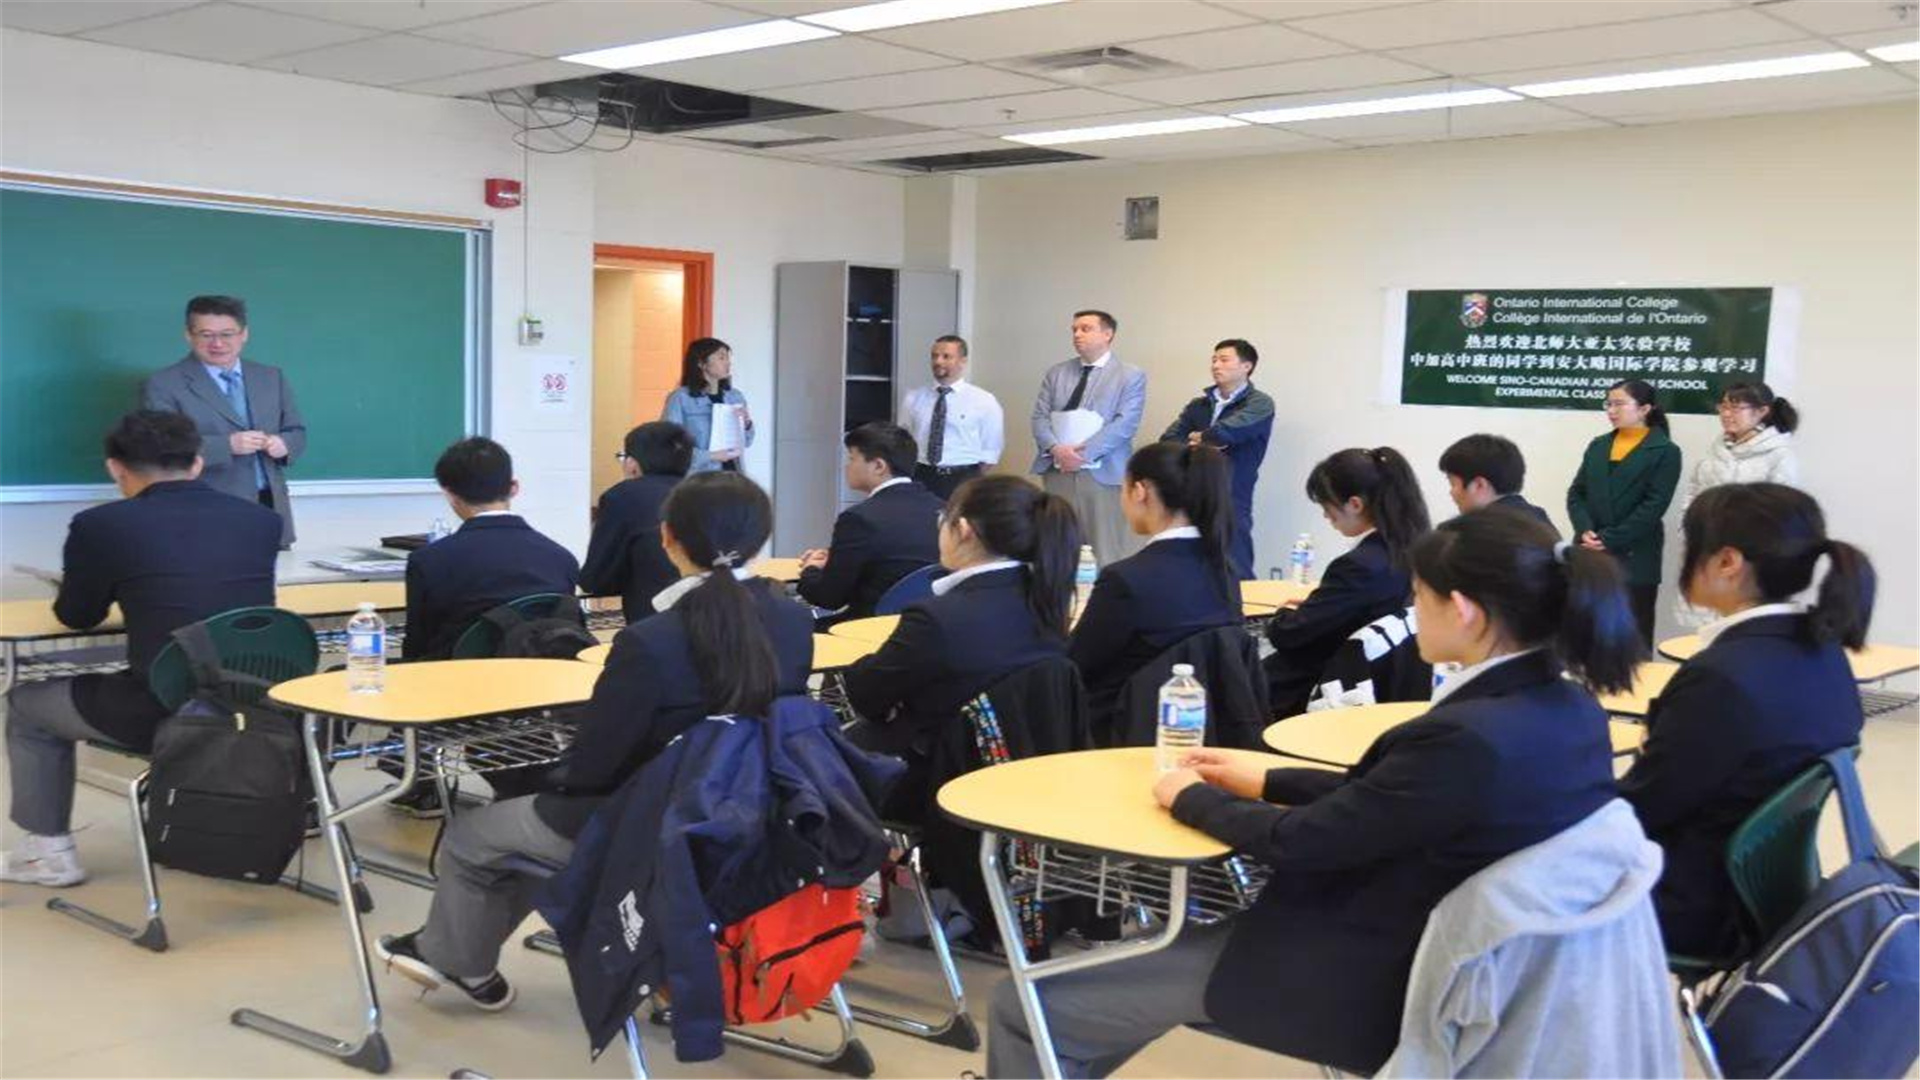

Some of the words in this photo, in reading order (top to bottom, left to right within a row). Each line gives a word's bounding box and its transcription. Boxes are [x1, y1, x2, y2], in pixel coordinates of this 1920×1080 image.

[1493, 297, 1540, 308] Ontario
[1543, 296, 1622, 309] International
[1626, 296, 1679, 311] College
[1492, 312, 1540, 326] Collège
[1543, 312, 1624, 325] International
[1627, 312, 1644, 325] de
[1446, 374, 1498, 385] WELCOME
[1499, 375, 1589, 387] SINO-CANADIAN
[1657, 379, 1708, 390] SCHOOL
[1495, 387, 1569, 399] EXPERIMENTAL
[1572, 388, 1607, 400] CLASS
